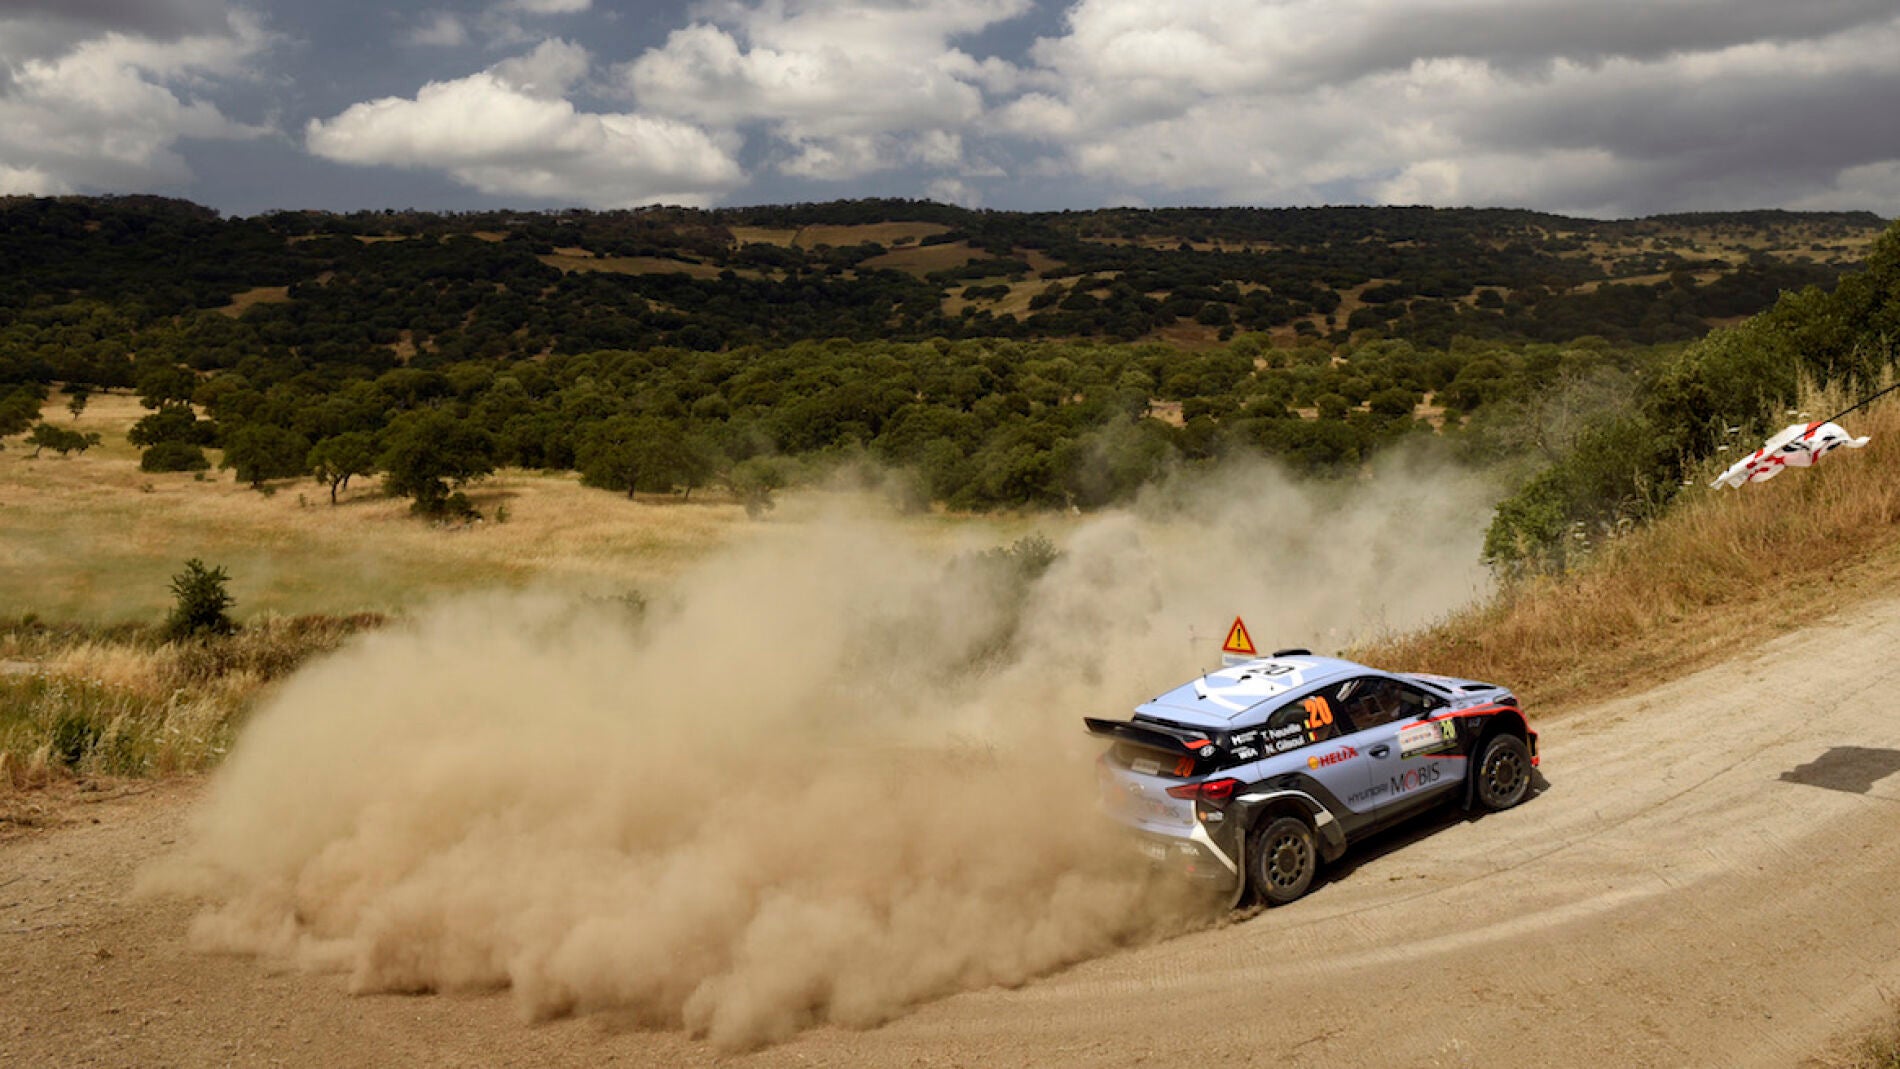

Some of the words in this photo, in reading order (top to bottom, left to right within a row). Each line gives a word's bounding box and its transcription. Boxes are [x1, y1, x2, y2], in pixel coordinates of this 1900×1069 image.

[1304, 696, 1333, 728] 20
[1440, 719, 1456, 740] 20
[1319, 745, 1359, 767] HELIX
[1173, 757, 1196, 778] 20
[1390, 762, 1441, 796] MOBIS
